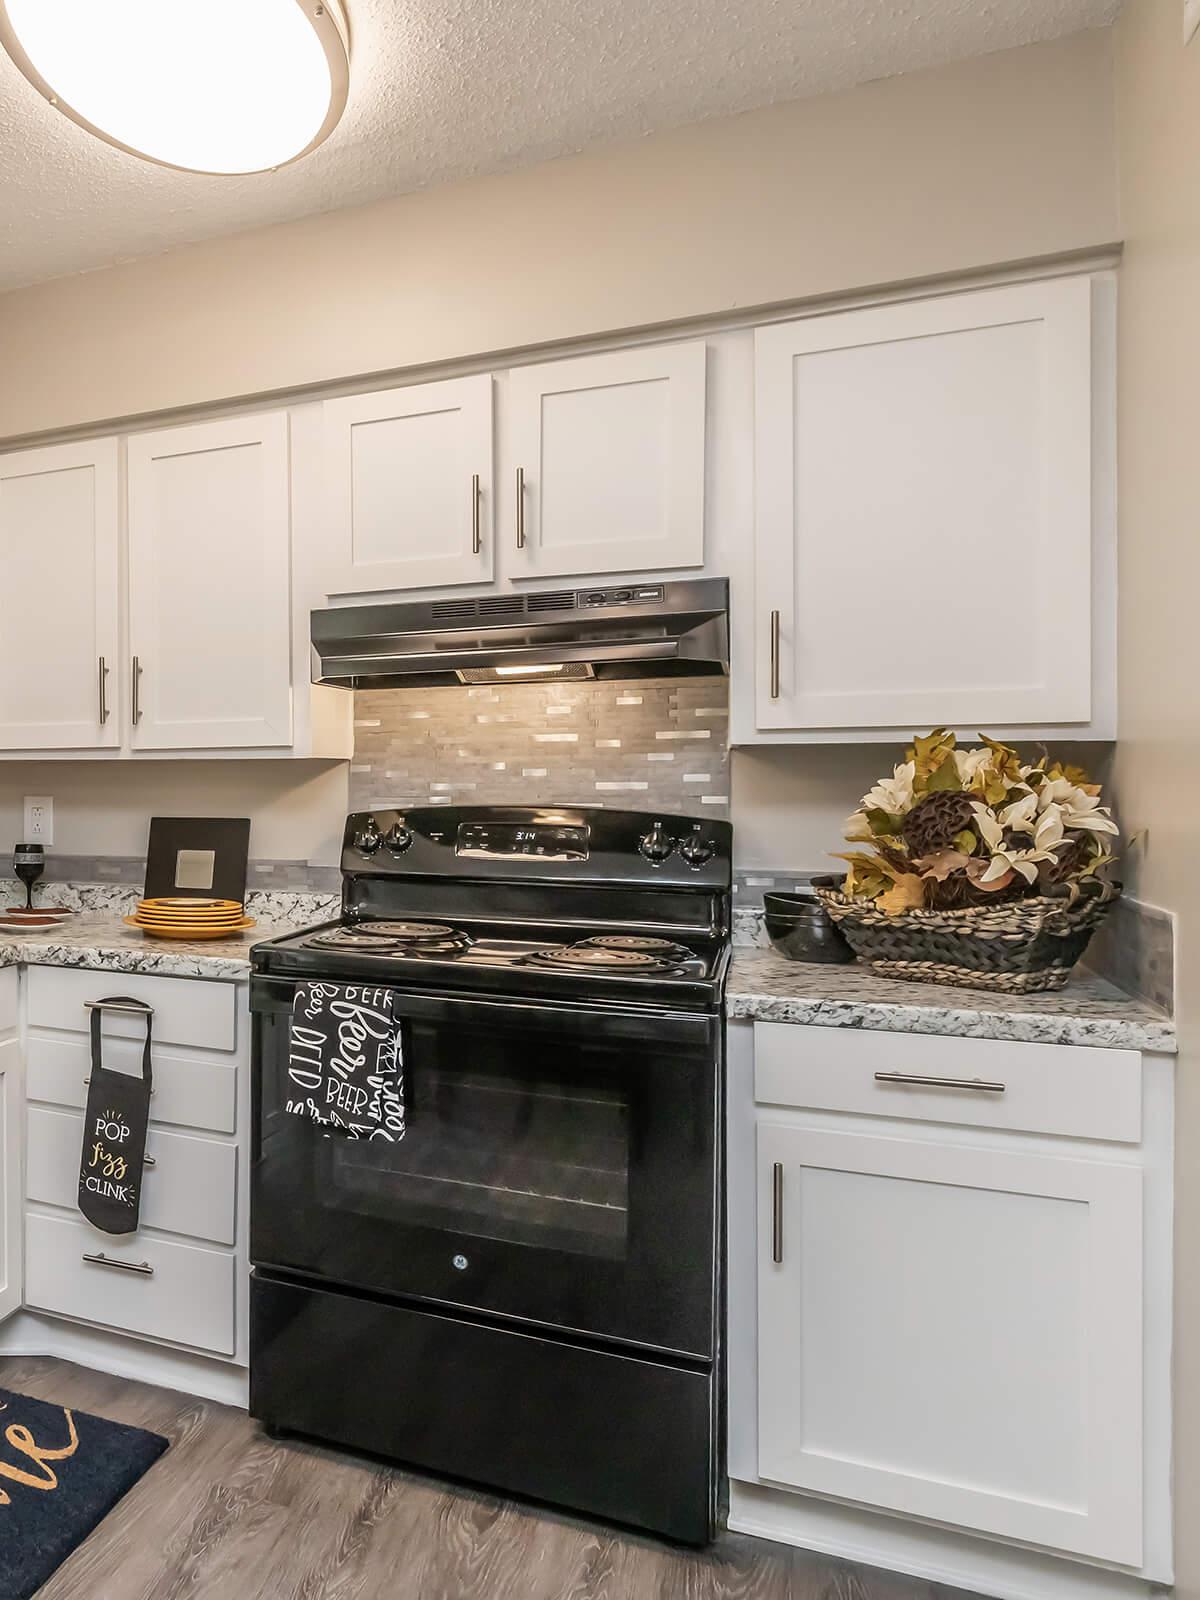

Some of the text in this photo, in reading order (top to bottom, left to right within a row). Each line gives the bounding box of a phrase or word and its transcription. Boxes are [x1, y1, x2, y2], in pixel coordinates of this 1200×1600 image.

[326, 1077, 369, 1115] BEER
[95, 1118, 130, 1143] POP
[88, 1142, 128, 1180] fizz
[86, 1176, 128, 1202] CLINK
